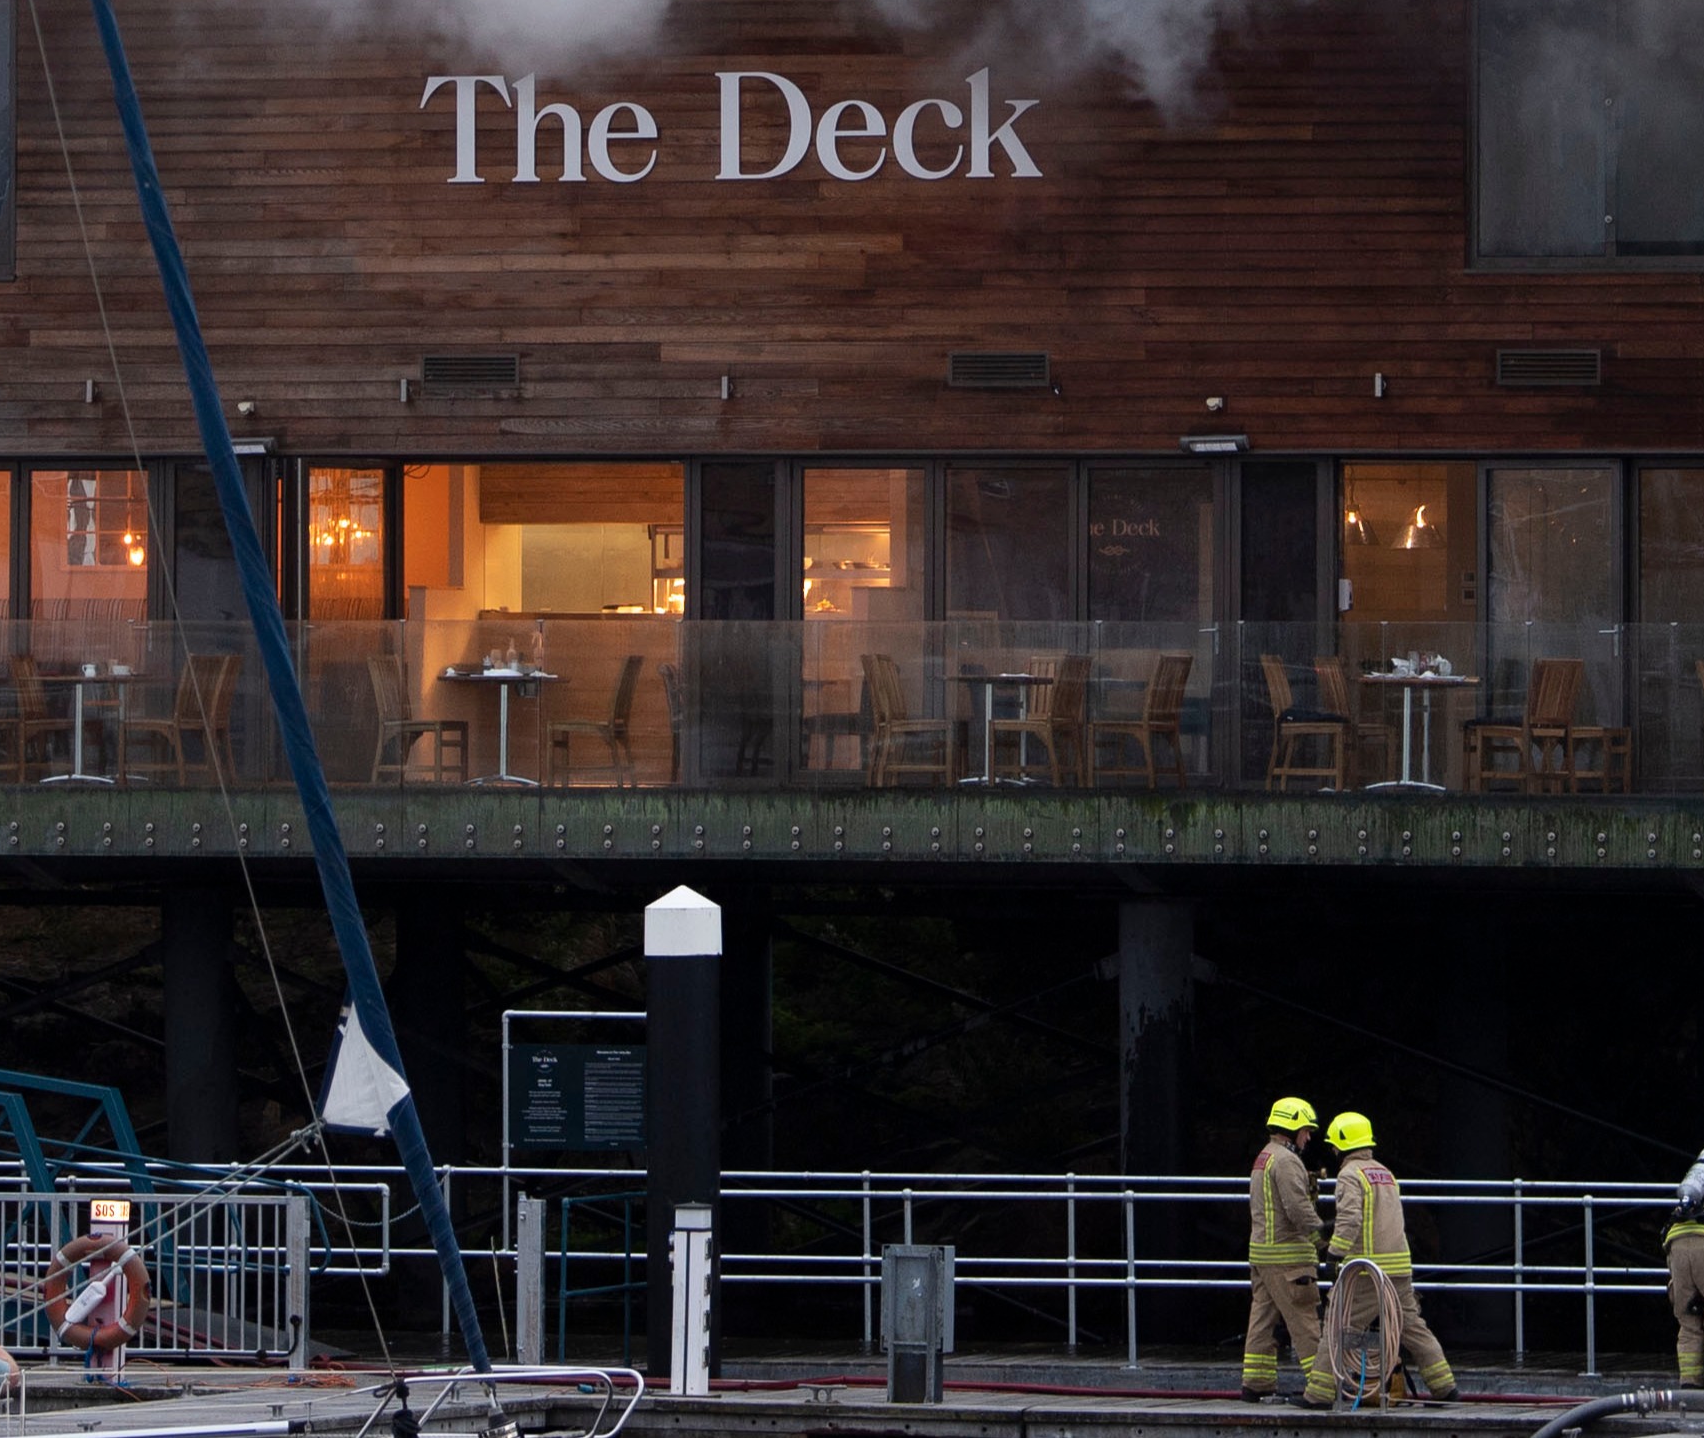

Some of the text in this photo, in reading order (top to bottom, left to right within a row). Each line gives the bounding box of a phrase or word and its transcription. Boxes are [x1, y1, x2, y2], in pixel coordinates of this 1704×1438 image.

[419, 66, 1045, 184] The Deck
[1112, 519, 1160, 537] Deck
[95, 1203, 115, 1218] SOS
